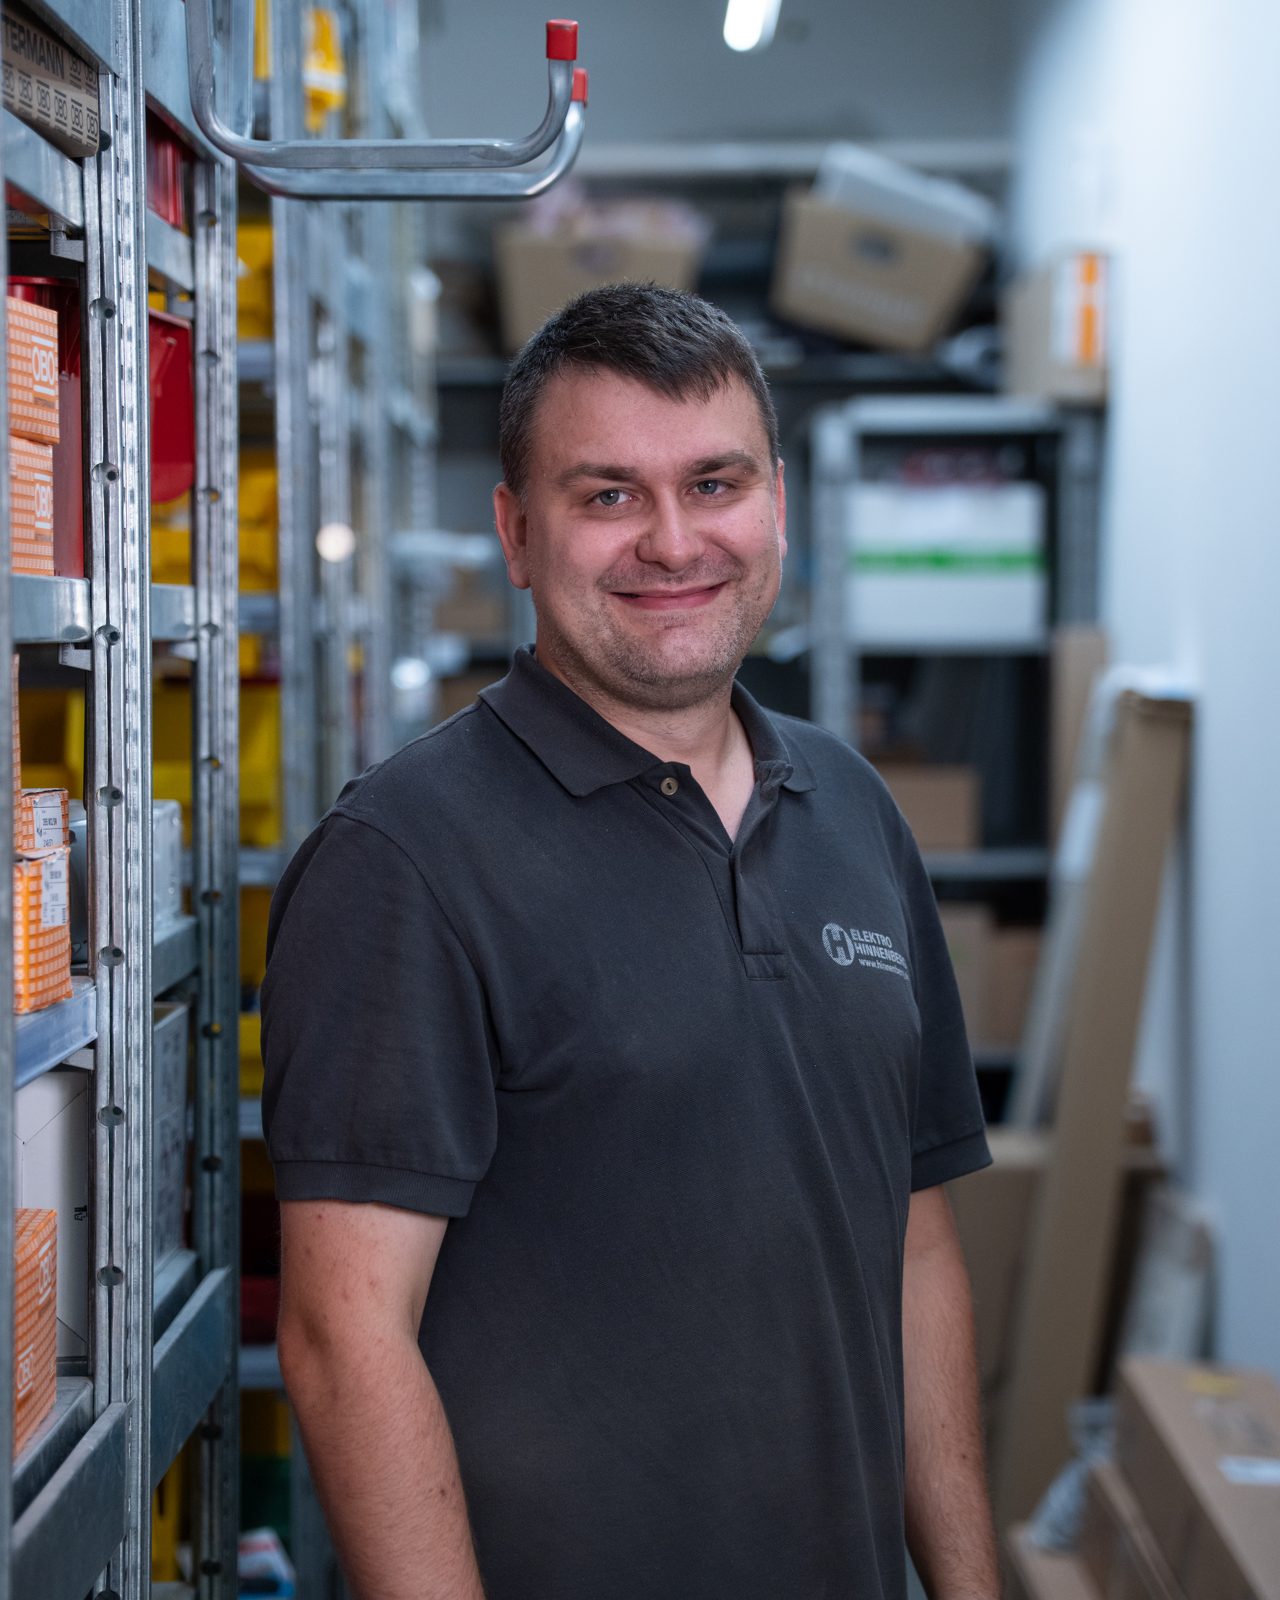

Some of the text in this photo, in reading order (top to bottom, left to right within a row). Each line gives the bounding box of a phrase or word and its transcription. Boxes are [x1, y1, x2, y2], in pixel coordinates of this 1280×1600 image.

[36, 85, 51, 111] OBO
[54, 94, 68, 121] OBO
[70, 104, 84, 130] OBO
[86, 113, 98, 138] OBO
[32, 345, 55, 385] OBO
[34, 483, 51, 519] OBO
[850, 928, 893, 949] ELEKTRO
